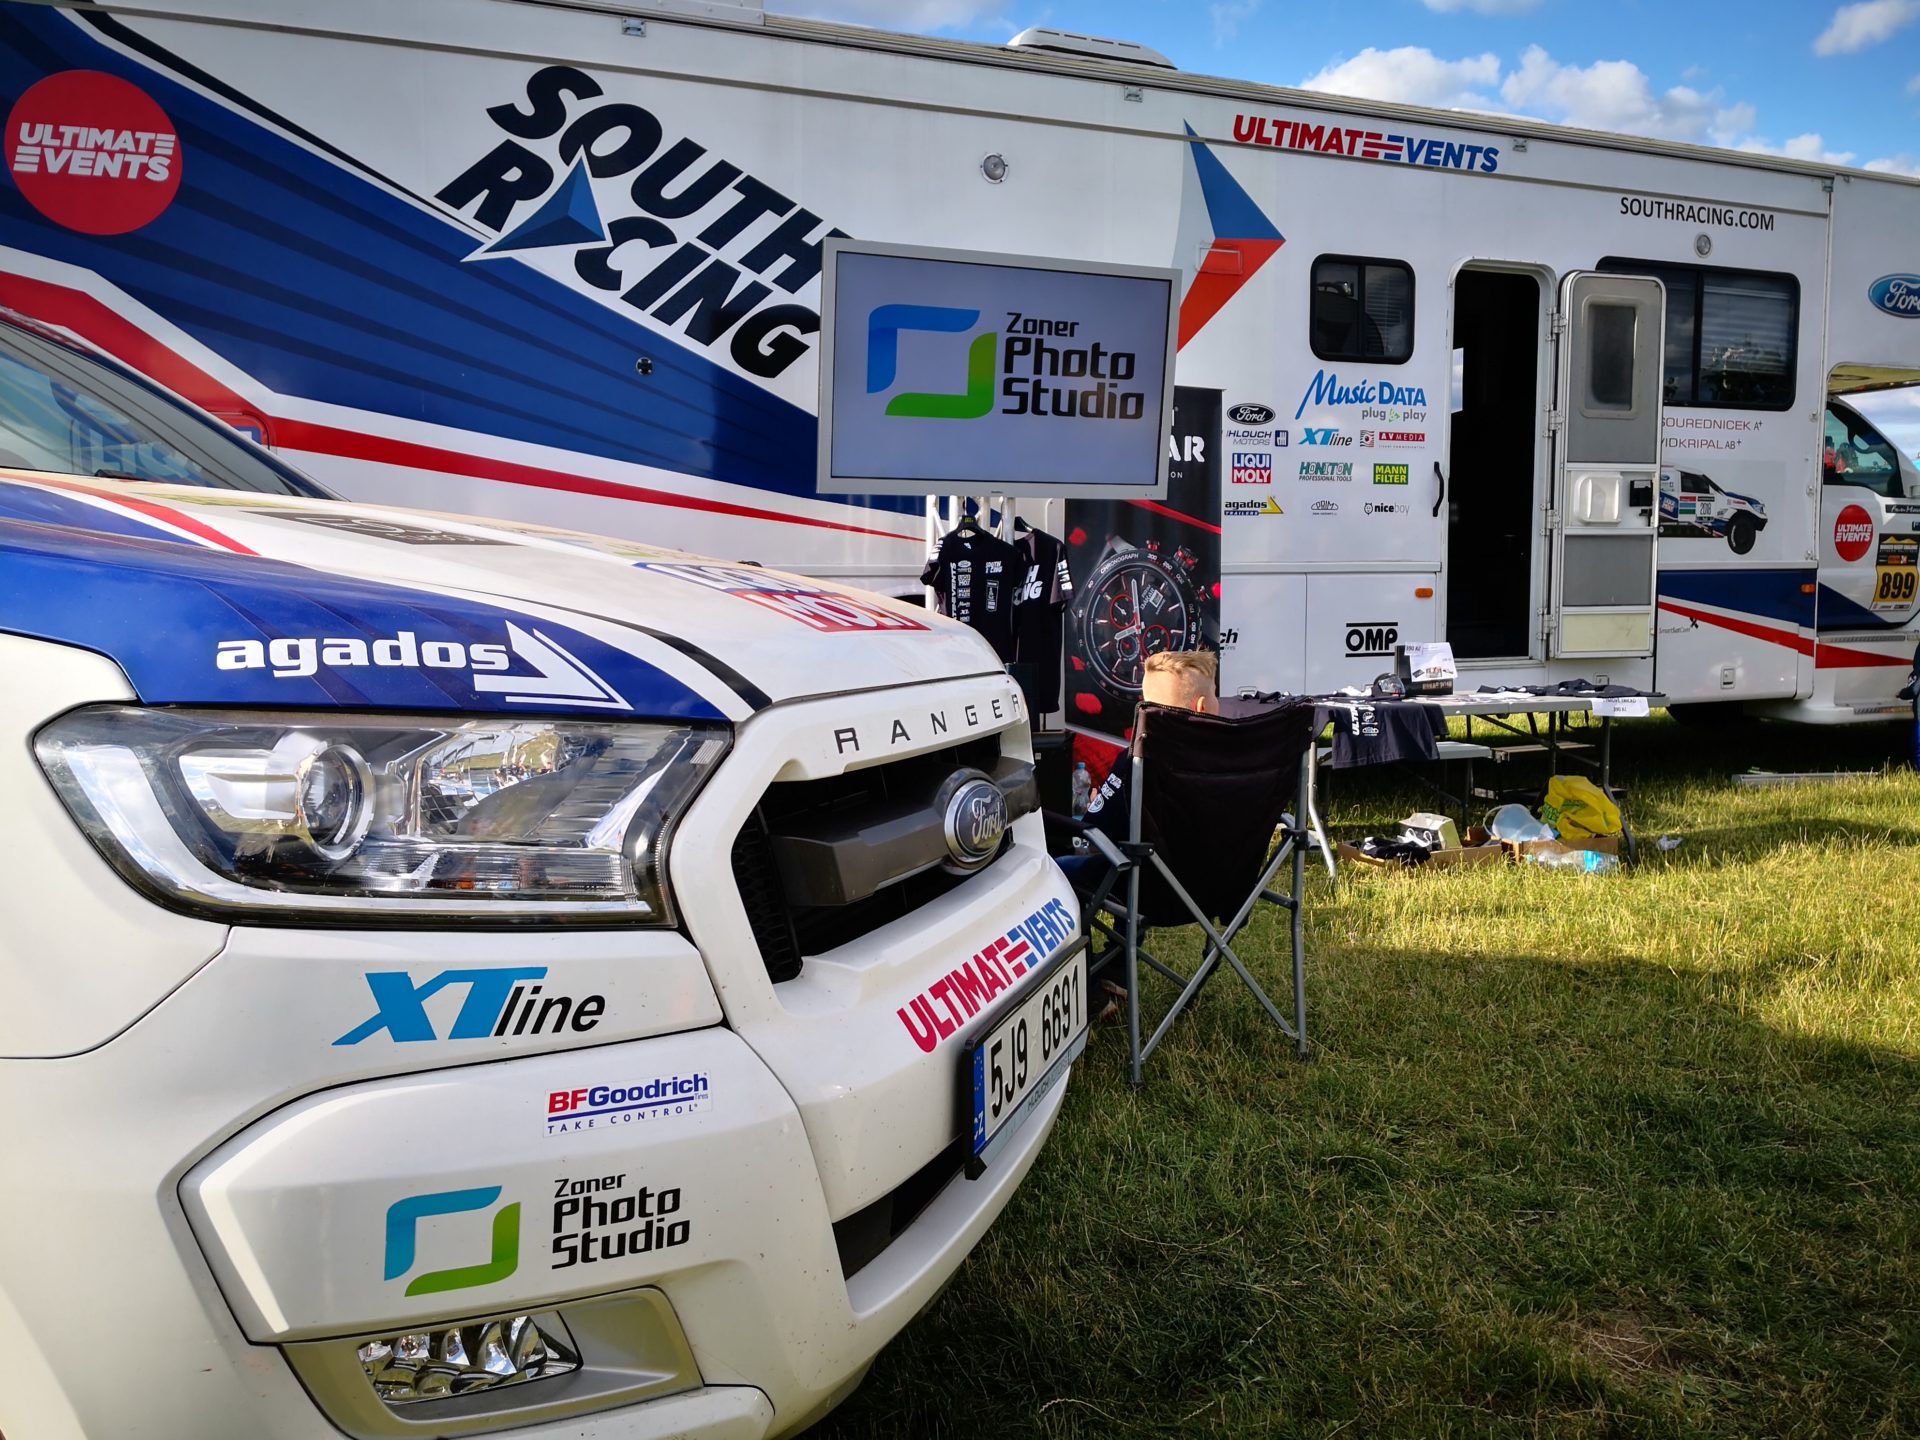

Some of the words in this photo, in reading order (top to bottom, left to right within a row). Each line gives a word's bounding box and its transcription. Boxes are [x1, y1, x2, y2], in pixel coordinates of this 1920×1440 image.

[19, 122, 176, 156] ULTIMATE
[13, 145, 171, 182] EVENTS
[1383, 135, 1500, 173] EVENTS
[1620, 196, 1775, 231] SOUTHRACING.COM
[1006, 312, 1080, 337] Zoner
[1003, 337, 1136, 380] Photo
[1002, 377, 1145, 420] Studio
[1237, 407, 1266, 421] Ford
[1361, 407, 1386, 422] plug
[1403, 409, 1427, 422] play
[1228, 430, 1272, 438] HLOUCH
[1233, 438, 1270, 446] MOTORS
[1298, 428, 1352, 447] XTline
[1233, 453, 1270, 468] LIQUI
[1300, 462, 1353, 475] HONITON
[1375, 465, 1406, 474] MANN
[1233, 469, 1270, 482] MOLY
[1375, 475, 1406, 483] FILTER
[1225, 500, 1267, 510] agados
[1835, 533, 1871, 543] EVENTS
[1837, 523, 1872, 533] ULTIMATE
[1100, 553, 1139, 574] CHRONOGRAPH
[1879, 572, 1915, 599] 899
[1346, 629, 1398, 651] OMP
[216, 632, 511, 678] agados
[834, 694, 1020, 754] RANGER
[972, 795, 1004, 845] Ford
[896, 937, 1030, 1053] ULTIMATE
[1007, 897, 1075, 969] EVENTS
[332, 967, 606, 1046] XTline
[991, 1018, 1028, 1118] 5J9
[1042, 964, 1079, 1061] 6691
[548, 1073, 708, 1114] BFGoodrich
[694, 1092, 709, 1100] Tires
[548, 1118, 596, 1135] TAKE
[610, 1104, 698, 1125] CONTROL
[554, 1174, 626, 1198] Zoner
[553, 1187, 681, 1234] Photo
[552, 1217, 690, 1270] Studio
